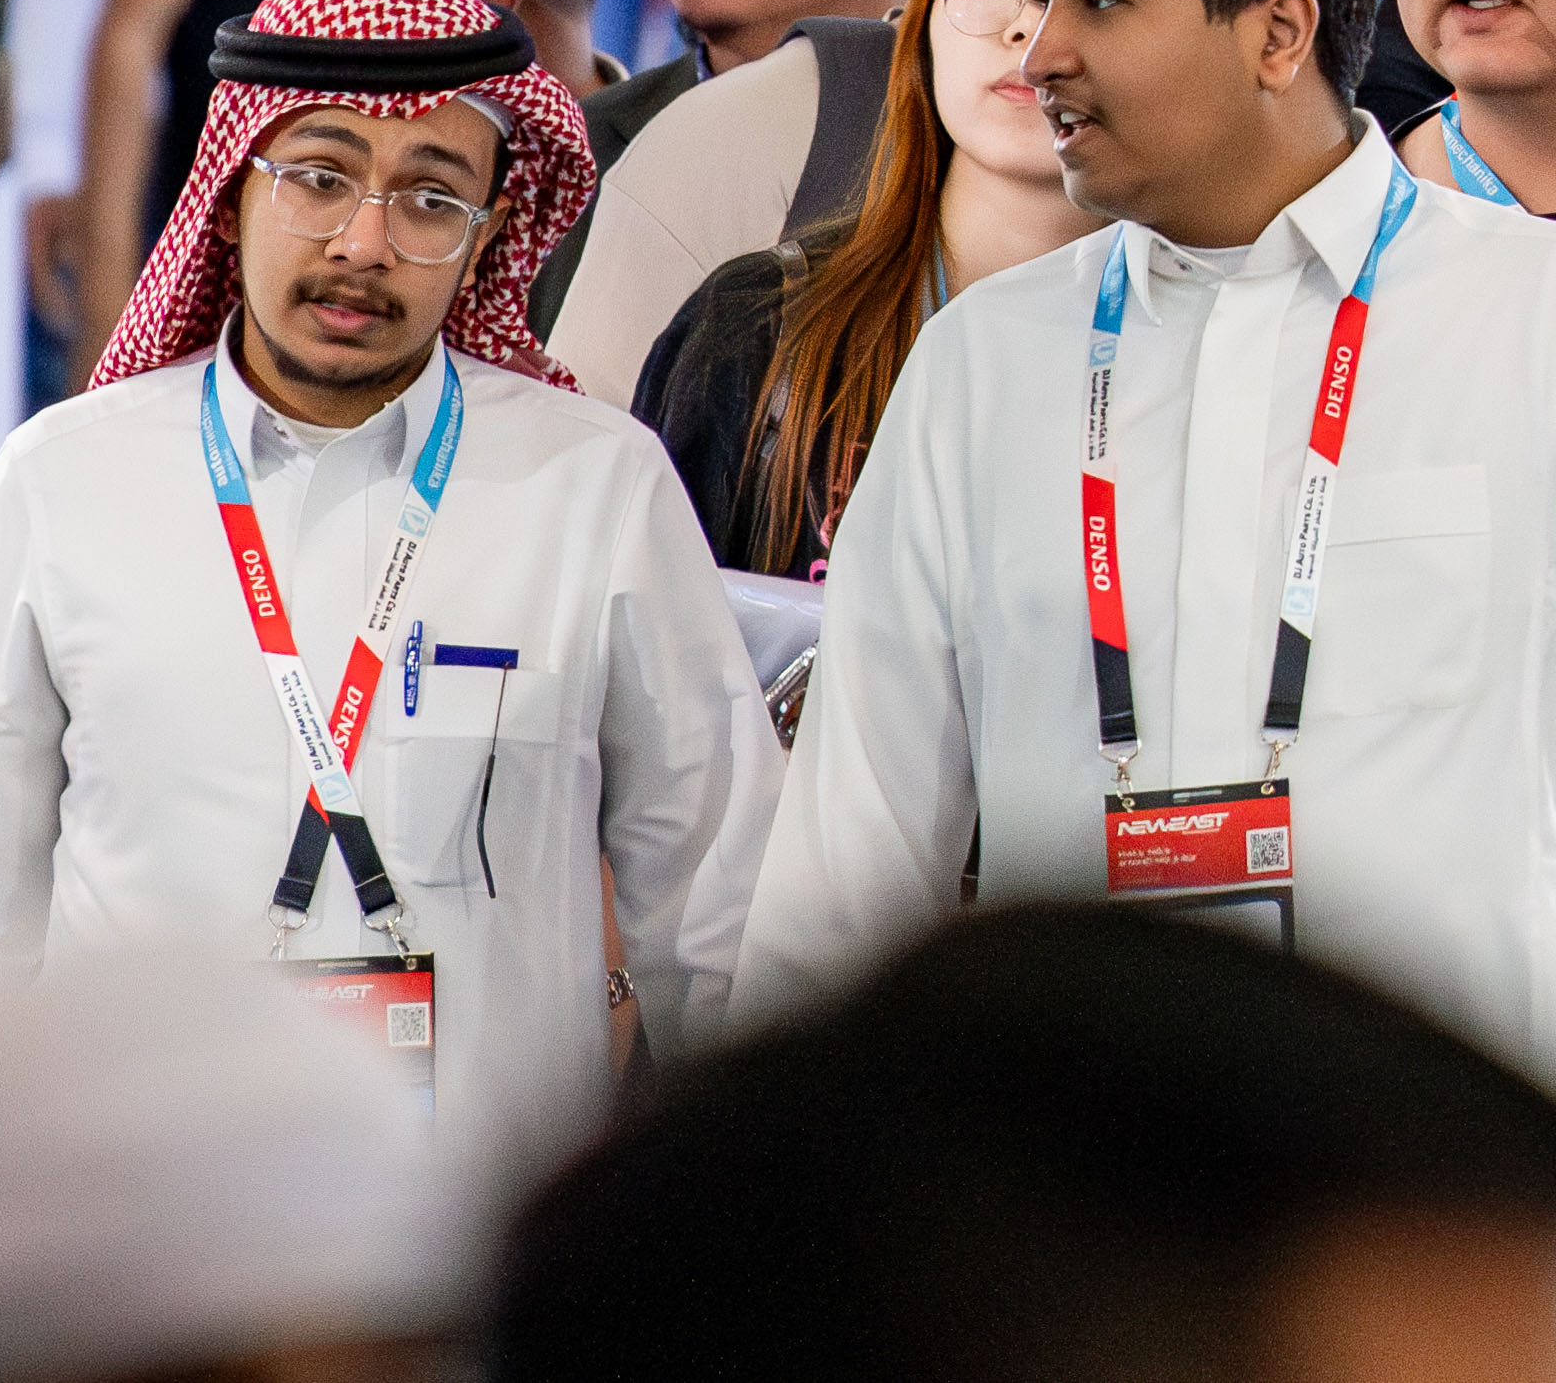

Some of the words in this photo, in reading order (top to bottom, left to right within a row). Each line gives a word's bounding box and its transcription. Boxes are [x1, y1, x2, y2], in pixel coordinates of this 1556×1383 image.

[1324, 345, 1353, 419] DENSO
[241, 548, 276, 619] DENSO
[1089, 514, 1112, 591] DENSO
[1117, 812, 1229, 836] NEWEAST
